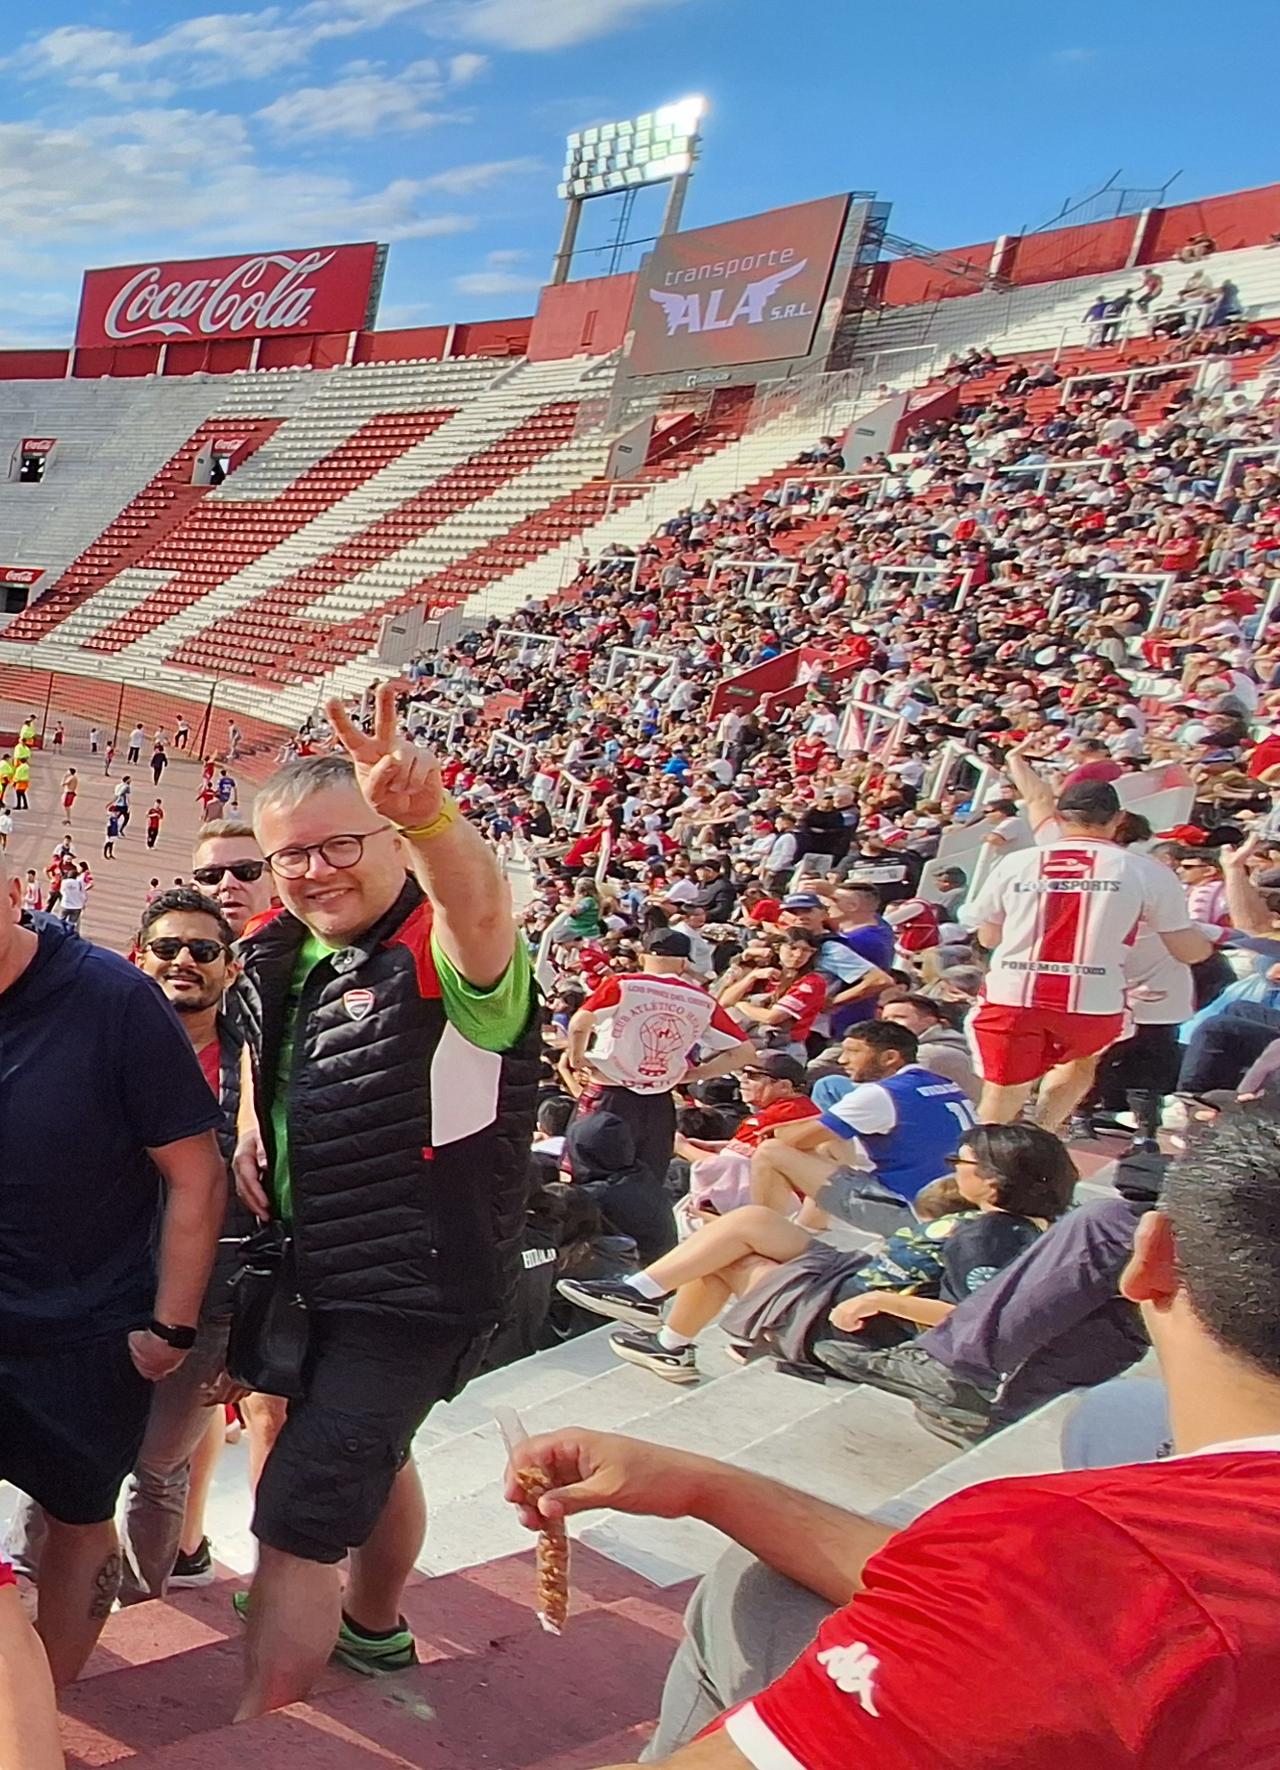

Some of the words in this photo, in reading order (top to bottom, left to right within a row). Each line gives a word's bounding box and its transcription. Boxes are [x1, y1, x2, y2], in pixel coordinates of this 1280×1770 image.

[665, 248, 794, 285] transporte
[104, 250, 337, 338] Coca-Cola
[652, 277, 772, 335] ALA
[770, 302, 812, 320] S.R.L.
[1060, 880, 1121, 892] SPORTS
[1001, 960, 1070, 974] PONEMOS
